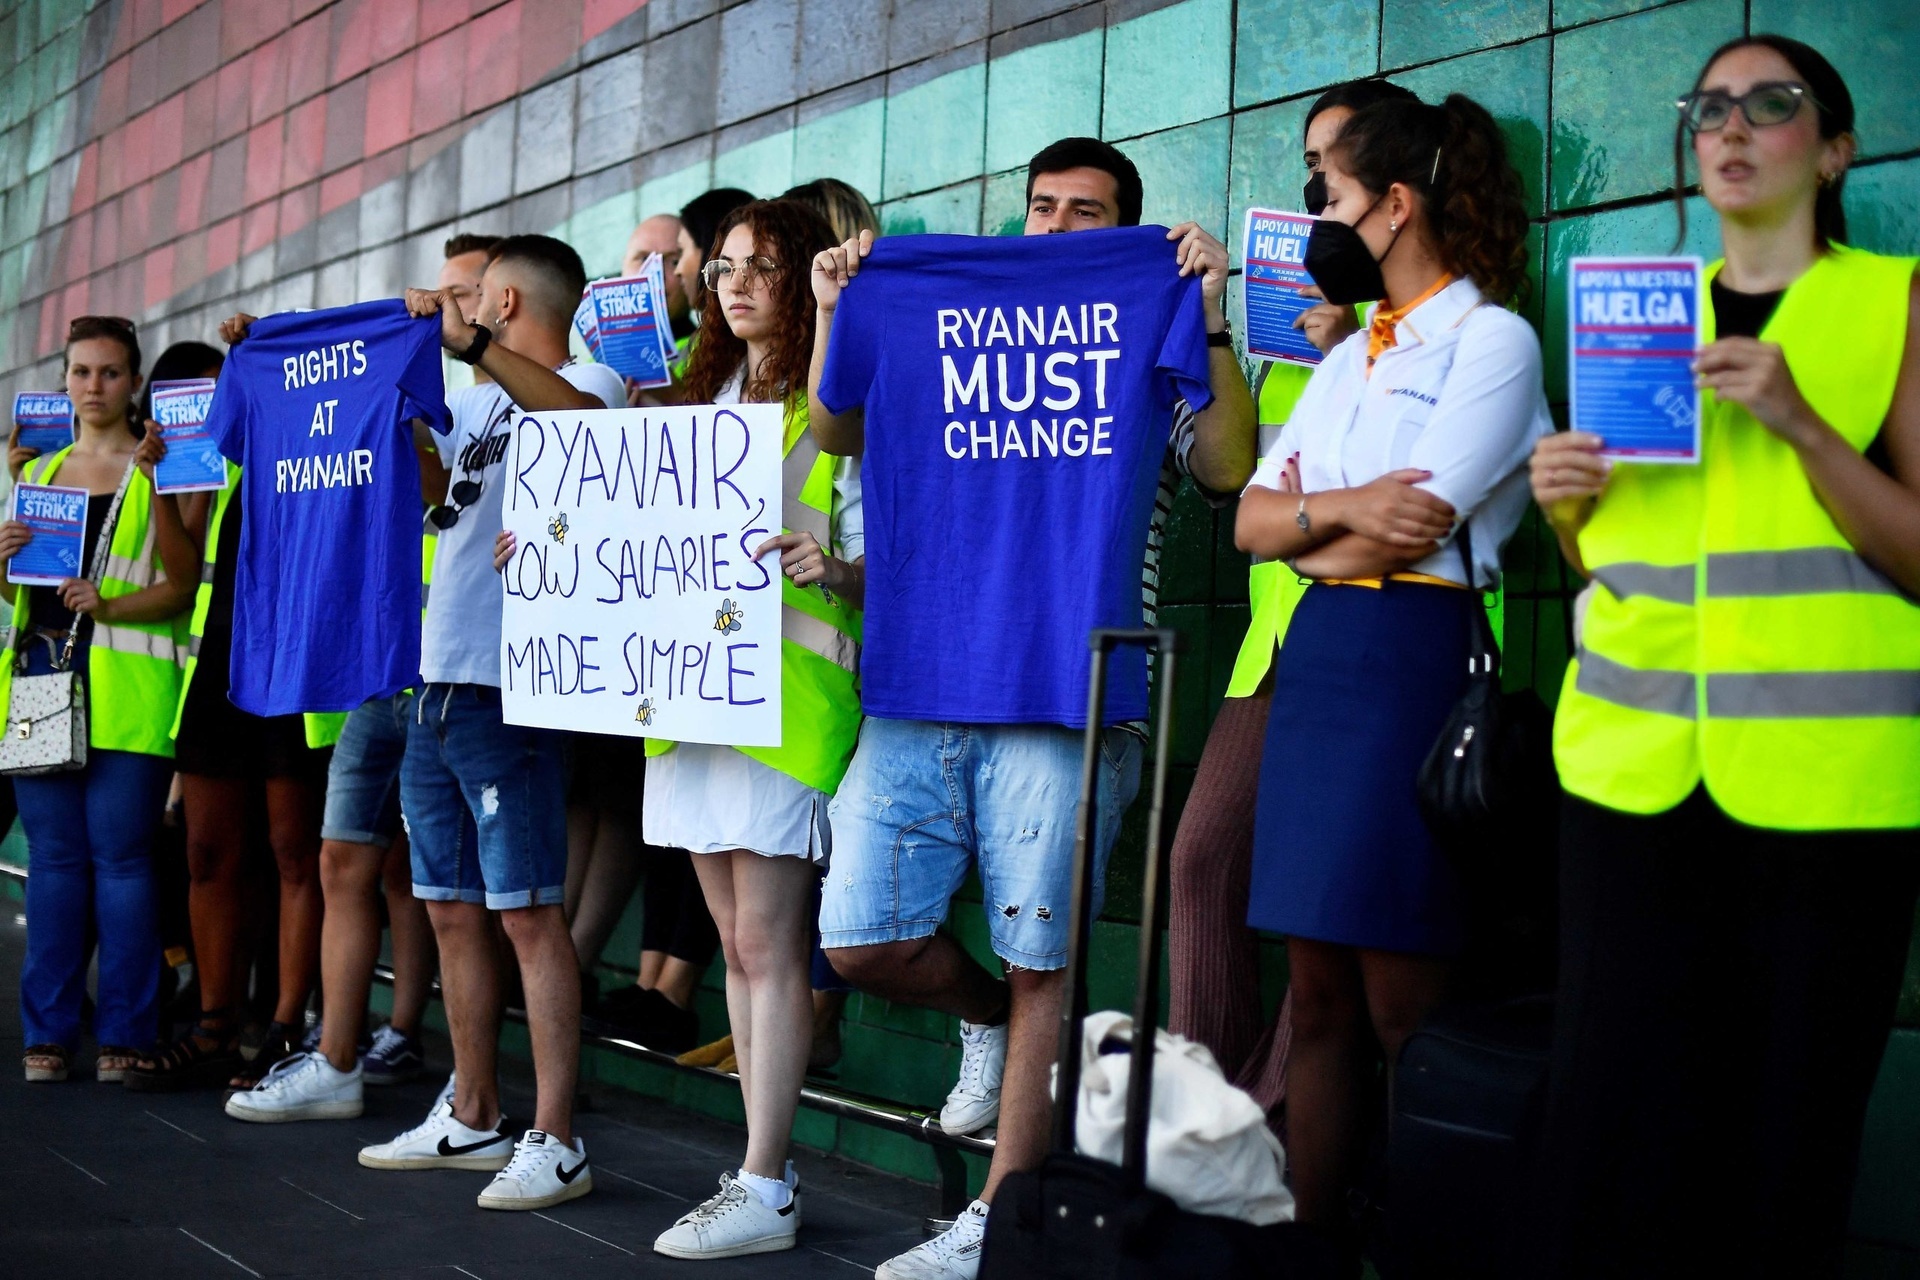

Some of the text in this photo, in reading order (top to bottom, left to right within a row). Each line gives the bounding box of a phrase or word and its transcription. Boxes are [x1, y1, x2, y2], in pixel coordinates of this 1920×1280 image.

[1254, 219, 1289, 234] APOYA
[1254, 234, 1303, 264] HUEL
[594, 282, 651, 301] SUPPORT OUR
[1579, 271, 1695, 288] APOYA NUESTRA
[600, 294, 649, 318] STRIKE
[1581, 290, 1690, 324] HUELGA
[937, 302, 1120, 349] RYANAIR
[283, 339, 368, 391] RIGHTS
[942, 349, 1121, 414] MUST
[20, 400, 69, 416] HUELGA
[155, 395, 195, 411] SUPPORT
[309, 399, 339, 438] AT
[944, 416, 1114, 460] CHANGE
[276, 449, 373, 494] RYANAIR
[512, 409, 765, 531] RYANAIR,
[20, 489, 84, 506] SUPPORT OUR
[24, 500, 78, 521] STRIKE
[504, 528, 771, 604] LOW SALARIES
[508, 631, 766, 705] MADE SIMPLE
